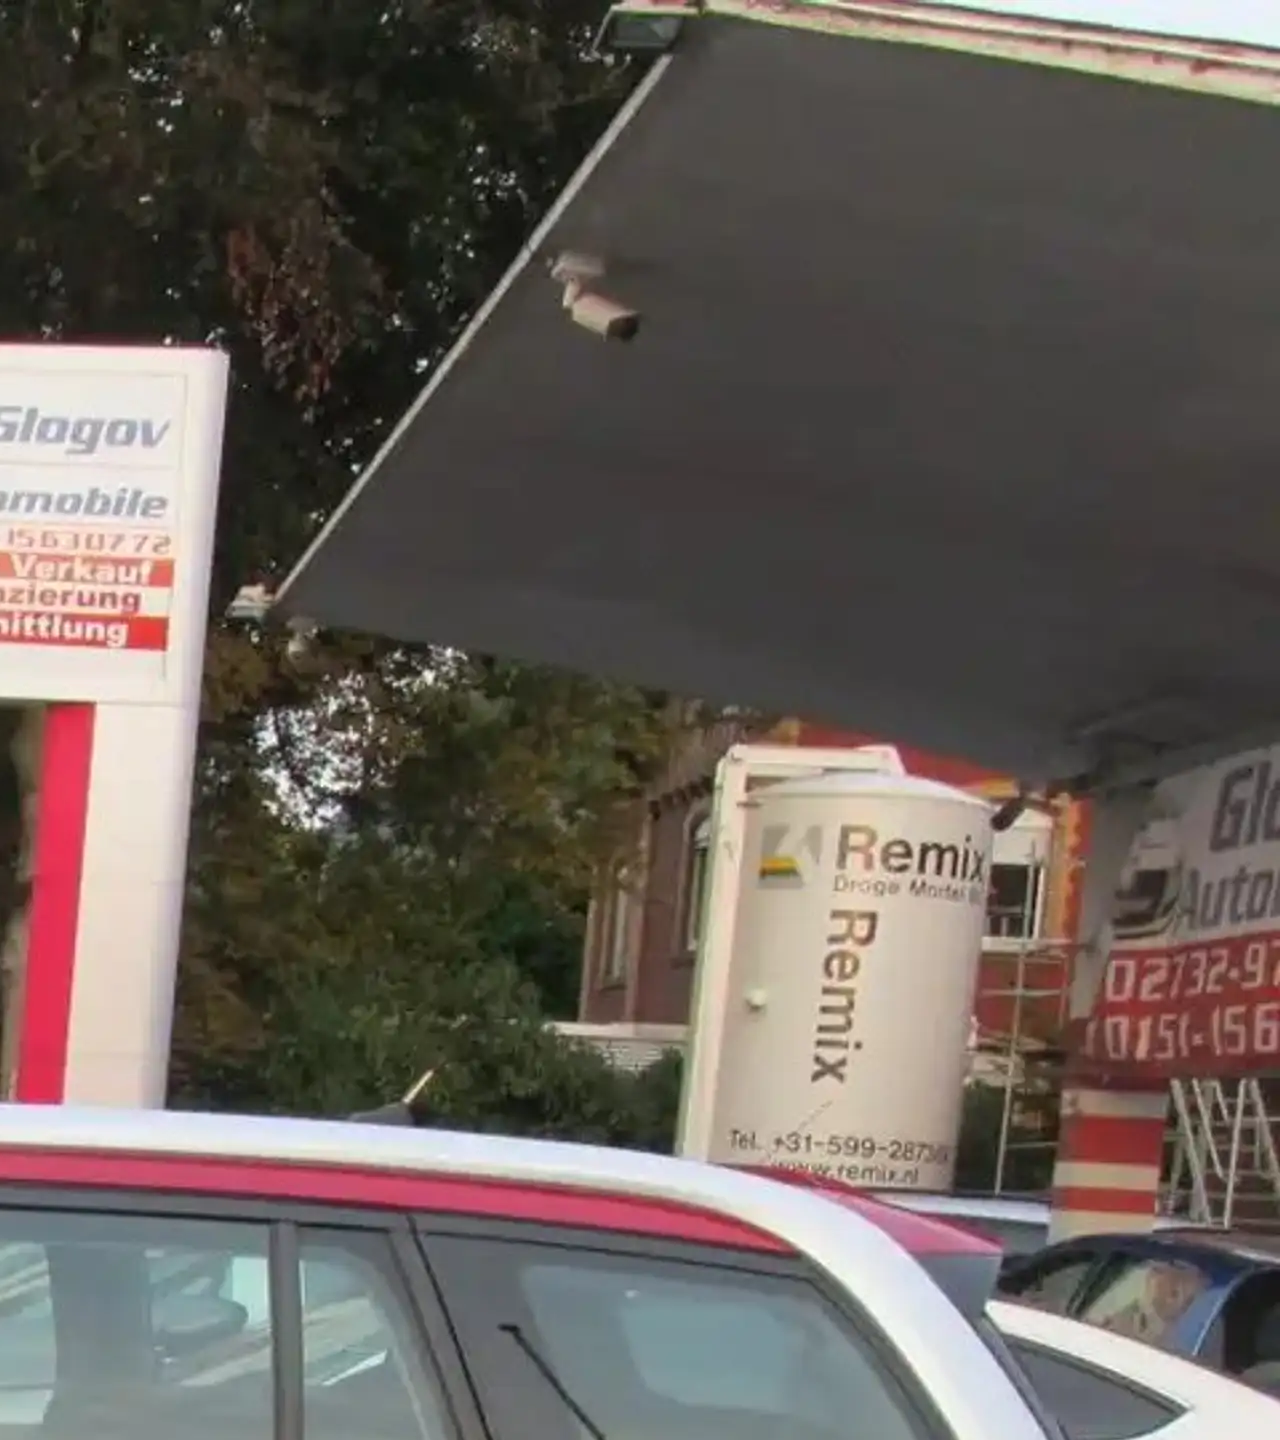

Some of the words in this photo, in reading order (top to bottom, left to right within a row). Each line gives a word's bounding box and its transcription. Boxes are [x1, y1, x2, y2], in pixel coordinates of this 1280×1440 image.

[10, 552, 154, 585] Verkauf
[836, 823, 984, 883] Remix
[811, 909, 878, 1084] Remix
